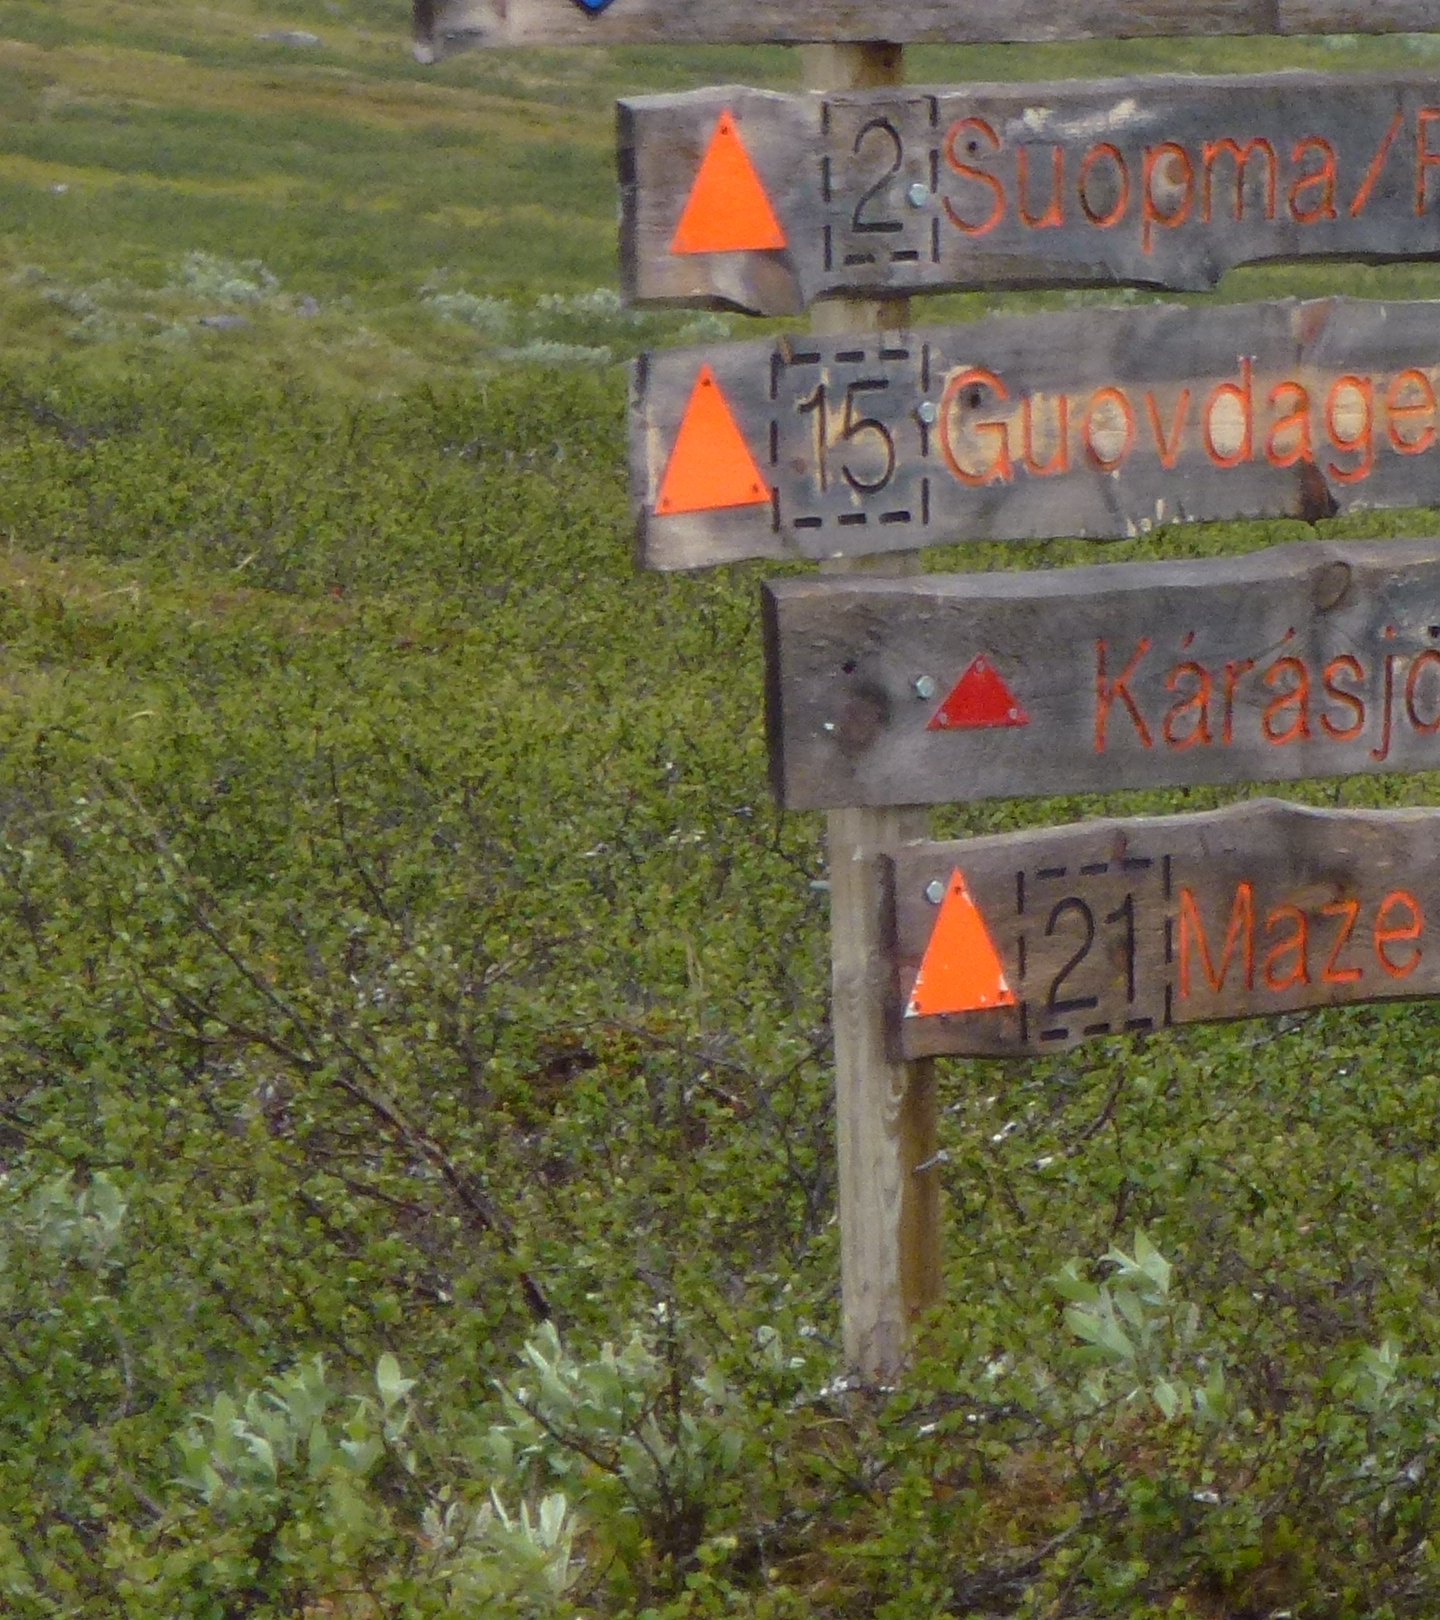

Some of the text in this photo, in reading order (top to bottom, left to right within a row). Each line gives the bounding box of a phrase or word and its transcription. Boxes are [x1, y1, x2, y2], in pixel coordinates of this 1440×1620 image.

[851, 116, 904, 234] 2
[797, 378, 896, 495] 15
[1044, 892, 1136, 1014] 21
[1176, 880, 1422, 999] Maze
